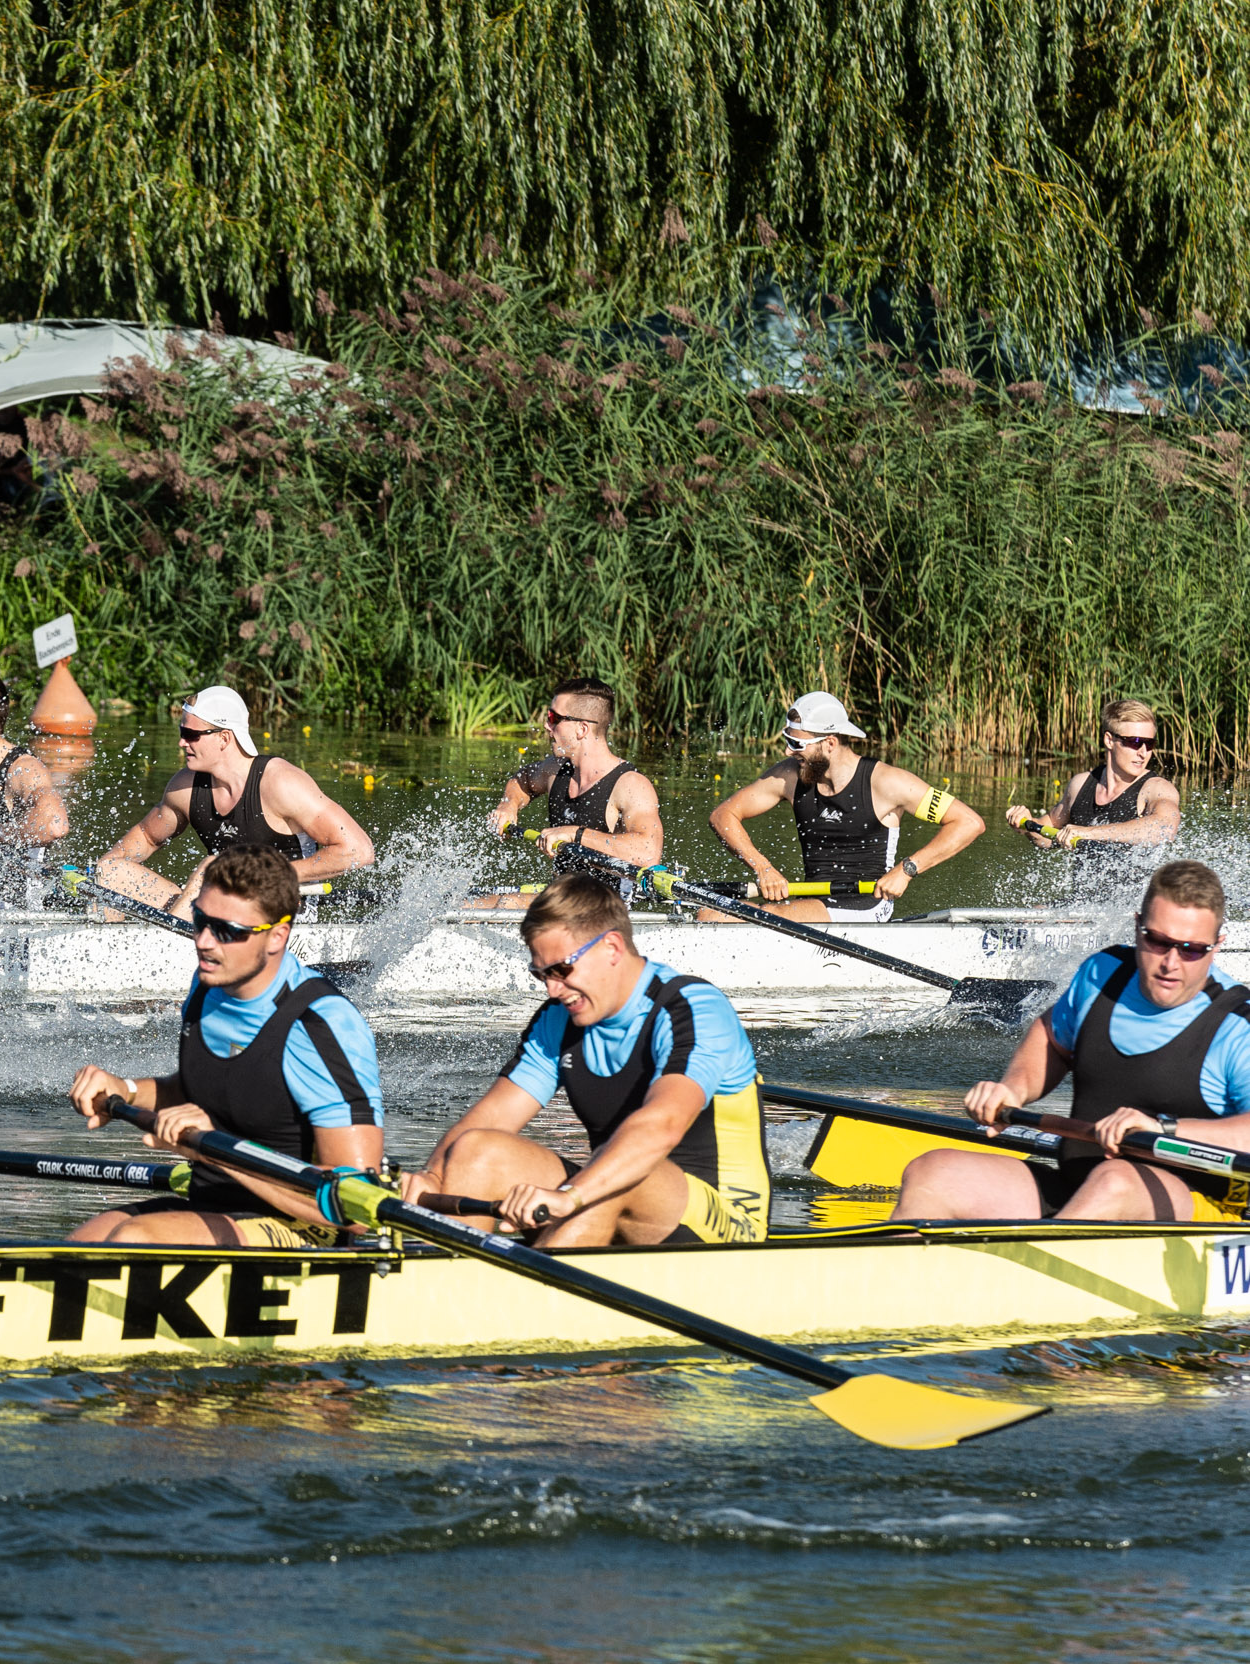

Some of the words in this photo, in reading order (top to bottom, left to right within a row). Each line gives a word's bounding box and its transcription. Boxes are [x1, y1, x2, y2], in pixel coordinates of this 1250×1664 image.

[46, 629, 61, 640] Ende
[37, 1161, 65, 1175] STARK.
[65, 1163, 102, 1178] SCHNELL.
[103, 1166, 123, 1180] GUT.
[128, 1165, 149, 1180] RBL
